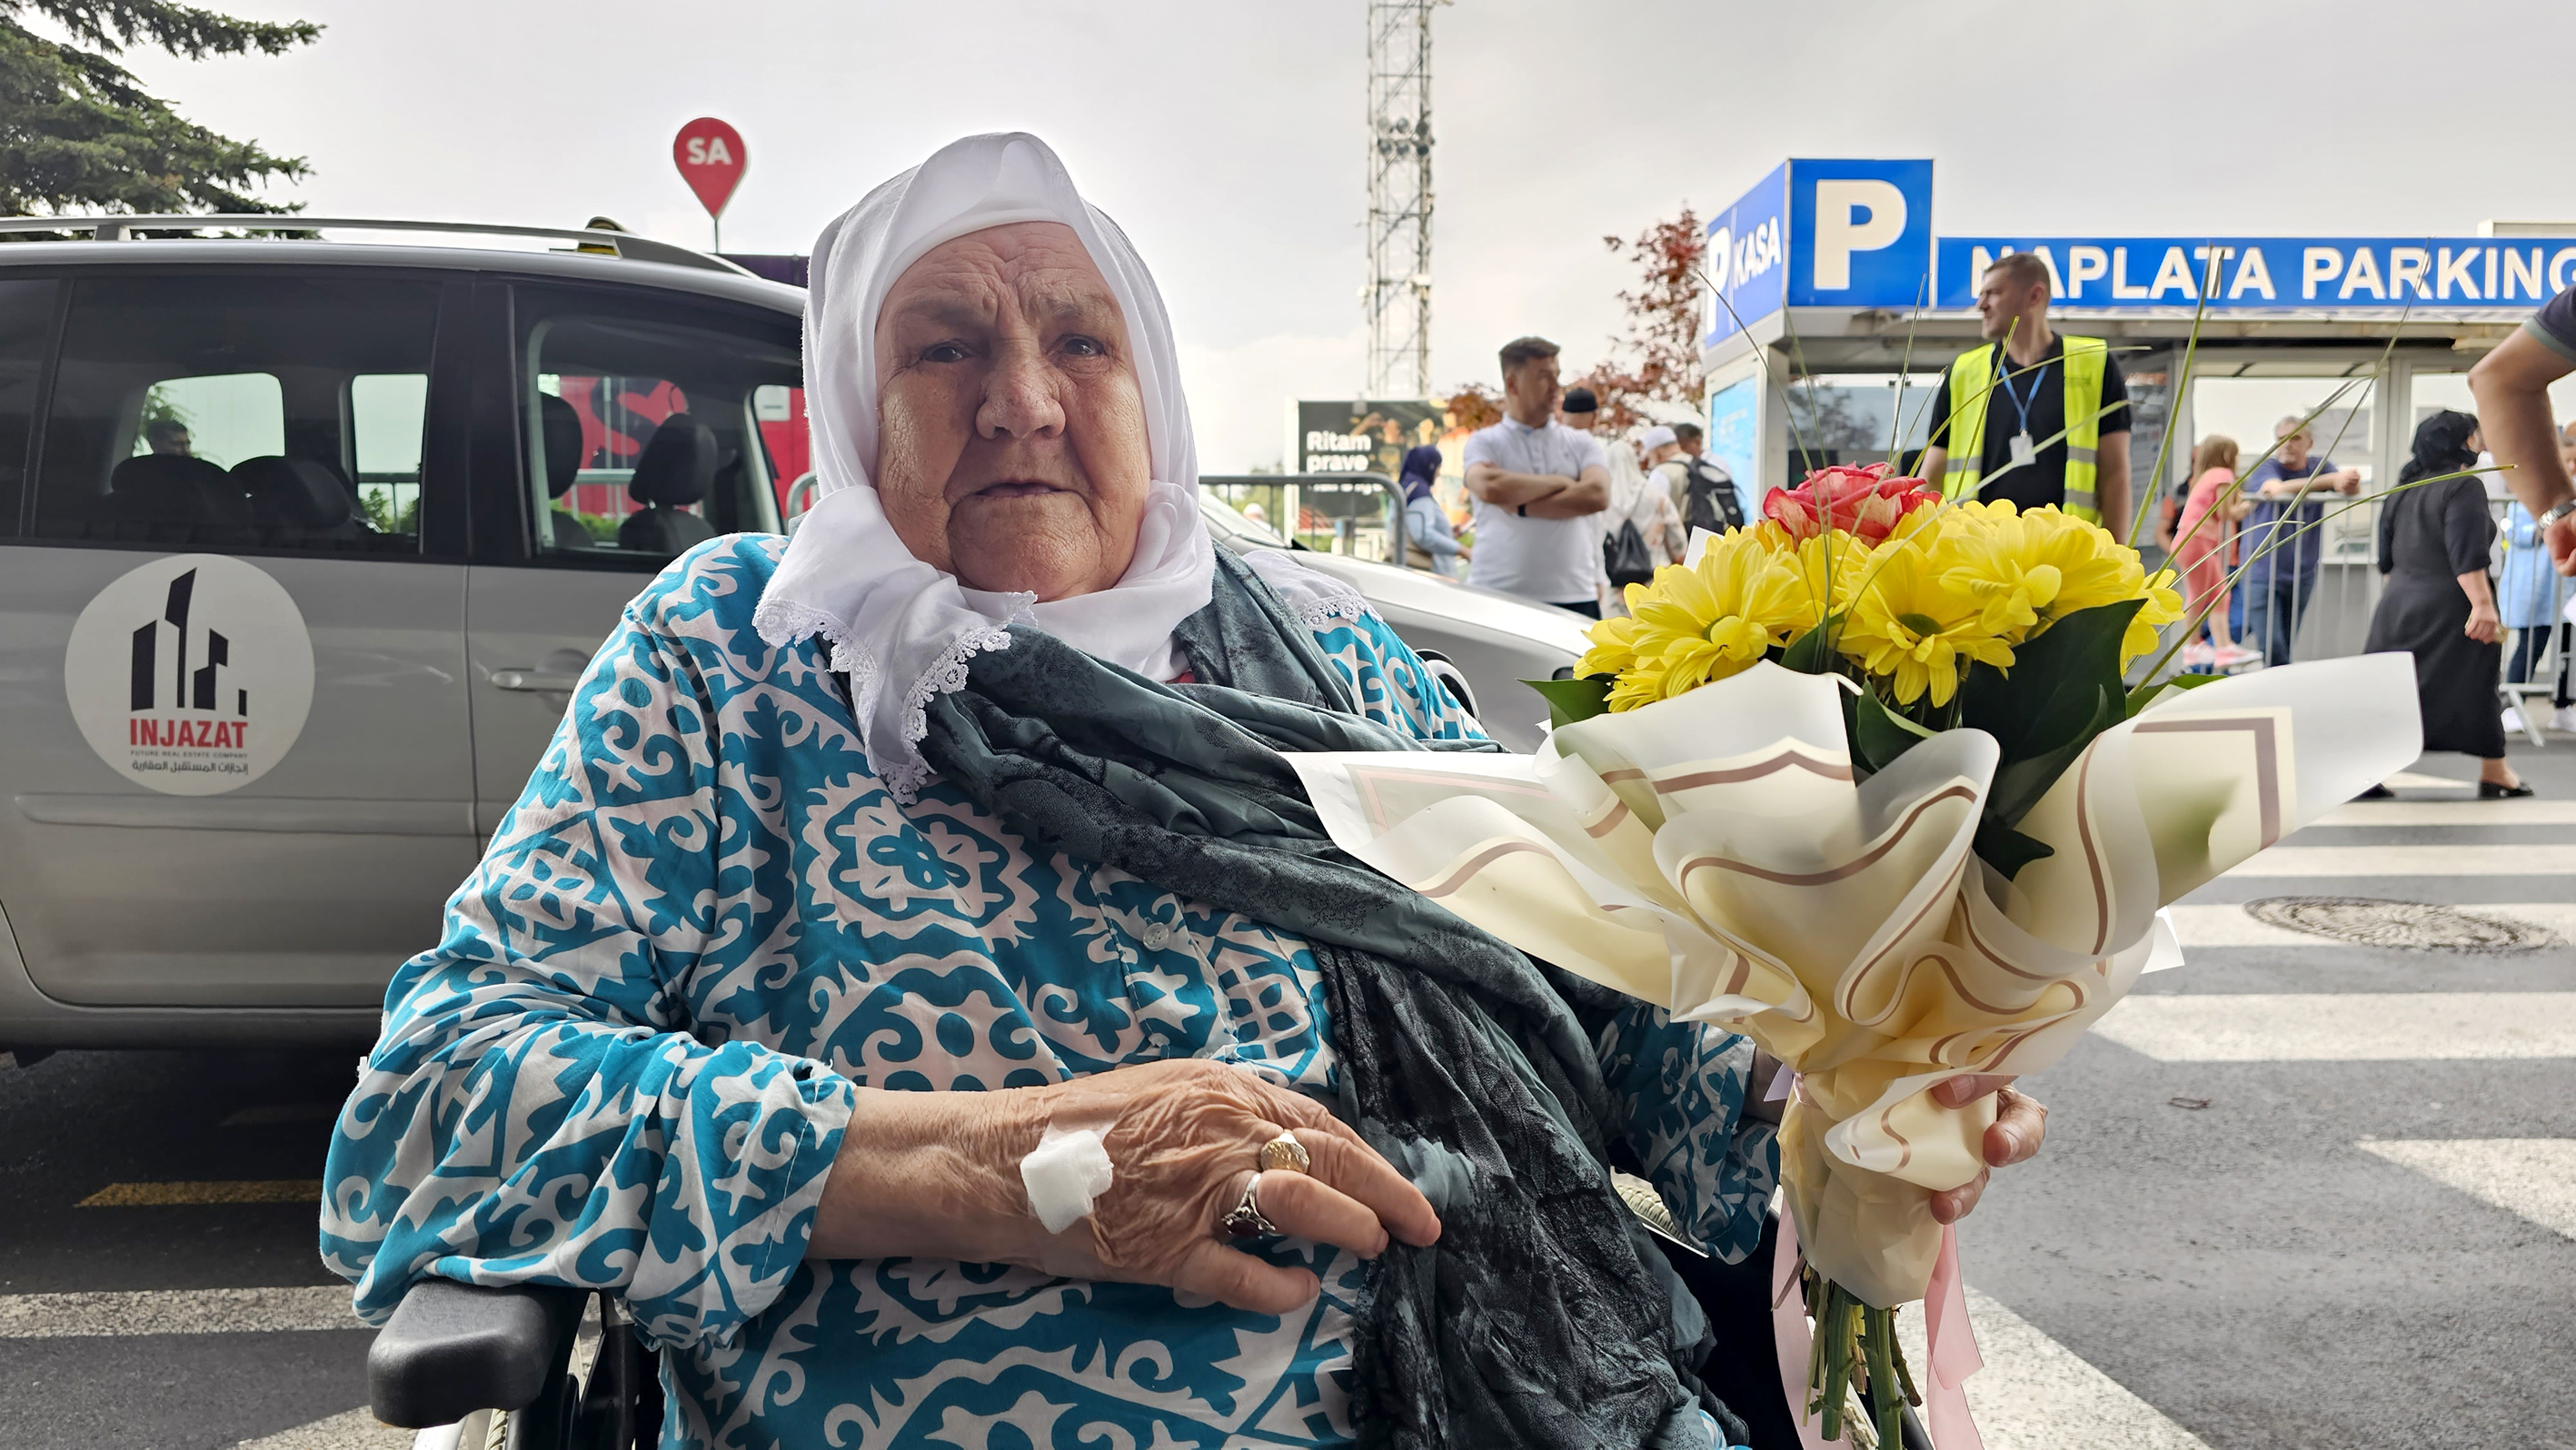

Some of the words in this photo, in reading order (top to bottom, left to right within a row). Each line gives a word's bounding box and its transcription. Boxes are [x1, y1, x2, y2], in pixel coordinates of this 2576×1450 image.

[686, 136, 733, 165] SA
[1813, 179, 1907, 290] P
[1707, 226, 1731, 335] P
[1734, 215, 1783, 290] KASA
[1307, 431, 1372, 452] Ritam
[130, 719, 248, 749] INJAZAT
[131, 750, 159, 758] FUTURE
[183, 750, 210, 759] ESTATE
[213, 751, 248, 760] COMPANY
[170, 760, 217, 774] المستقبل
